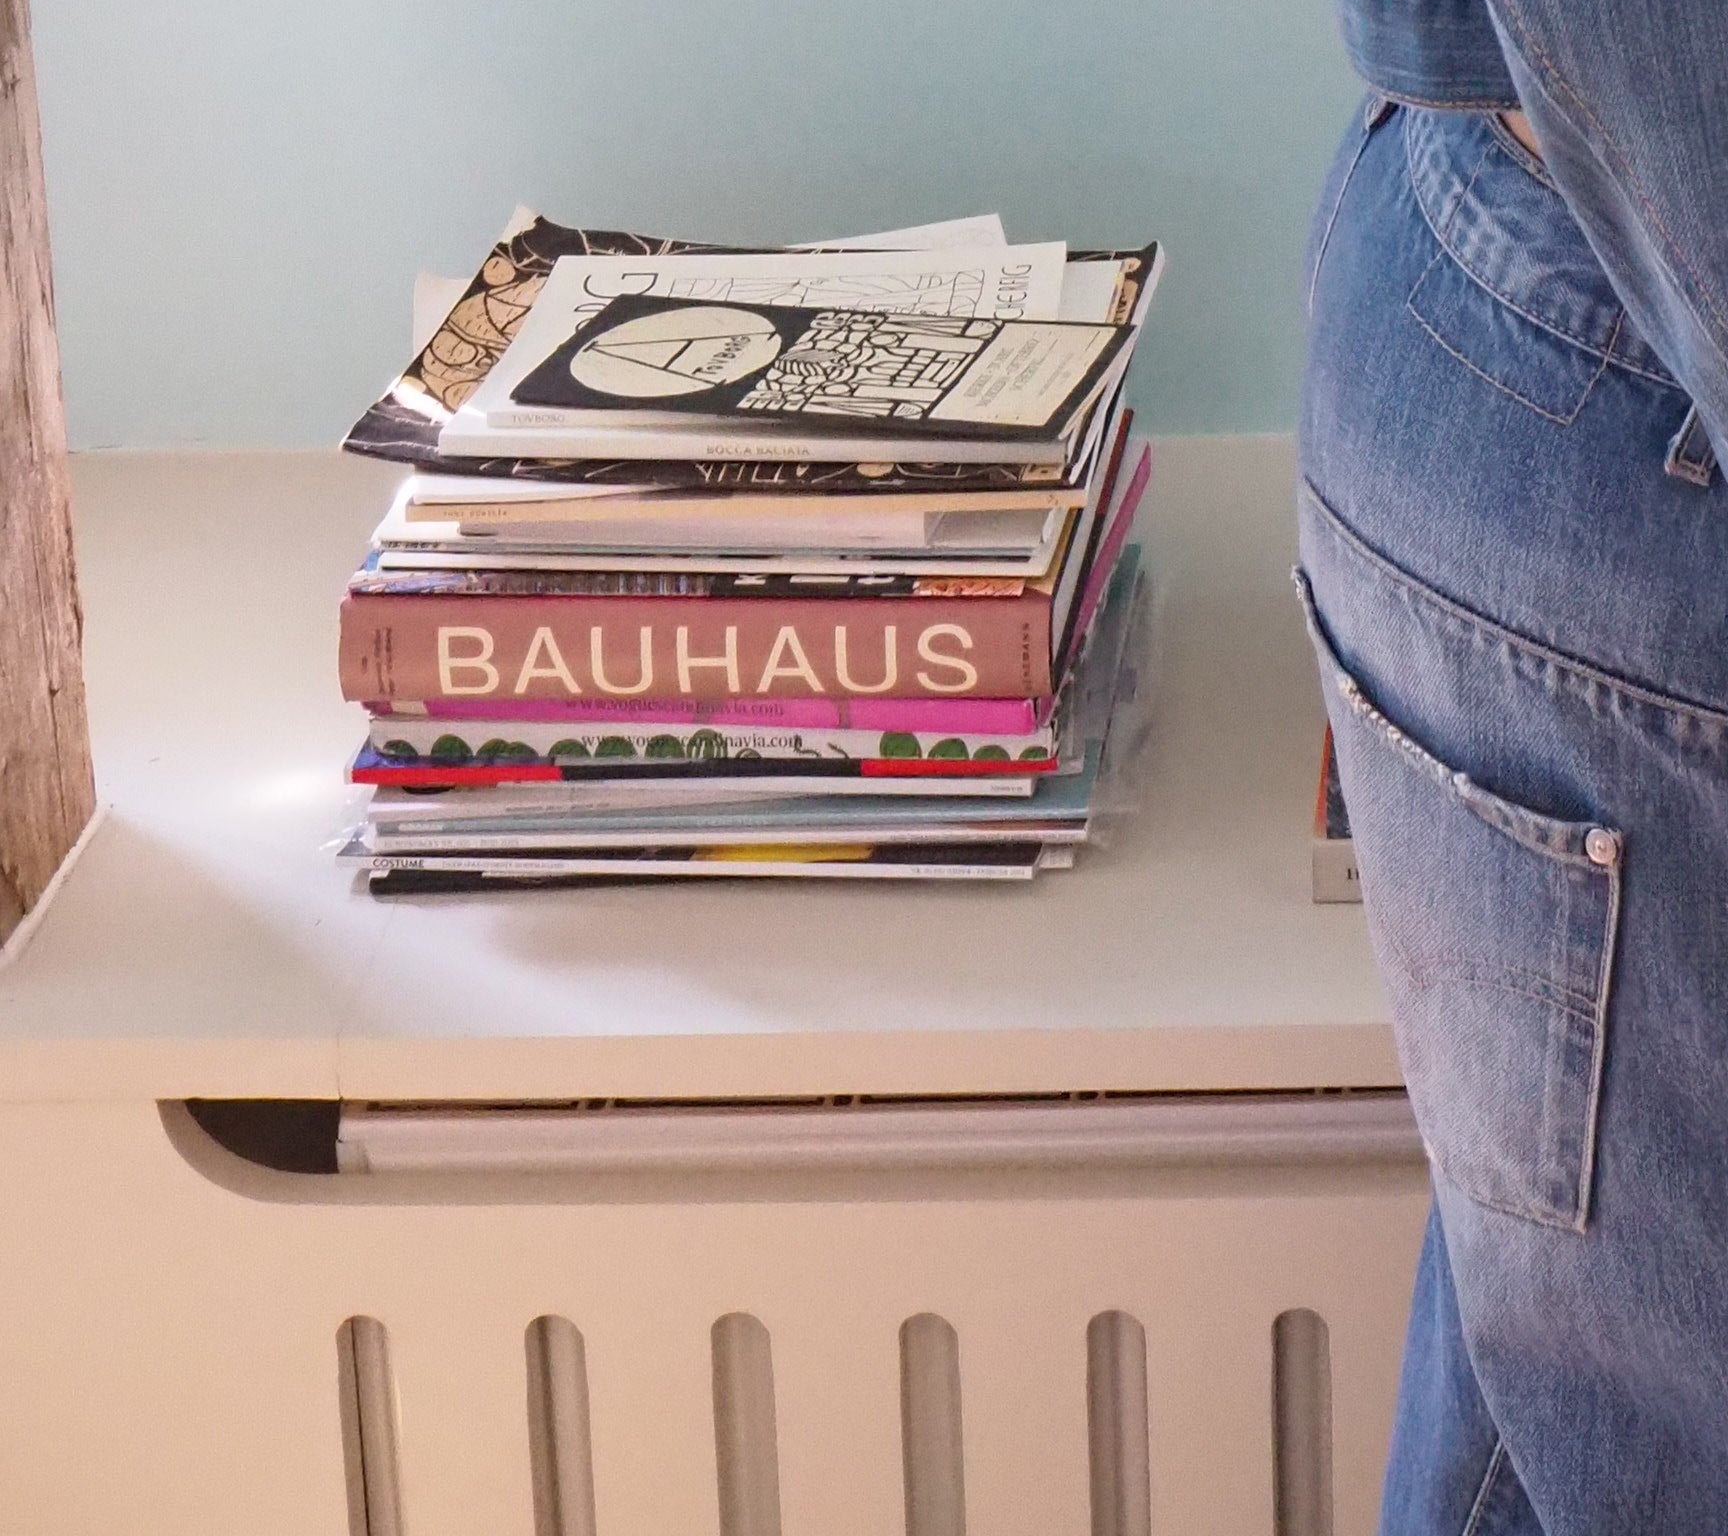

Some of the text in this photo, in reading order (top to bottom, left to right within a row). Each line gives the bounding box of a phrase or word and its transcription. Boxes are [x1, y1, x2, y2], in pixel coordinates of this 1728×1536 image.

[706, 445, 752, 456] BOCCA
[437, 623, 978, 696] BAUHAUS
[372, 858, 425, 870] COSTUME
